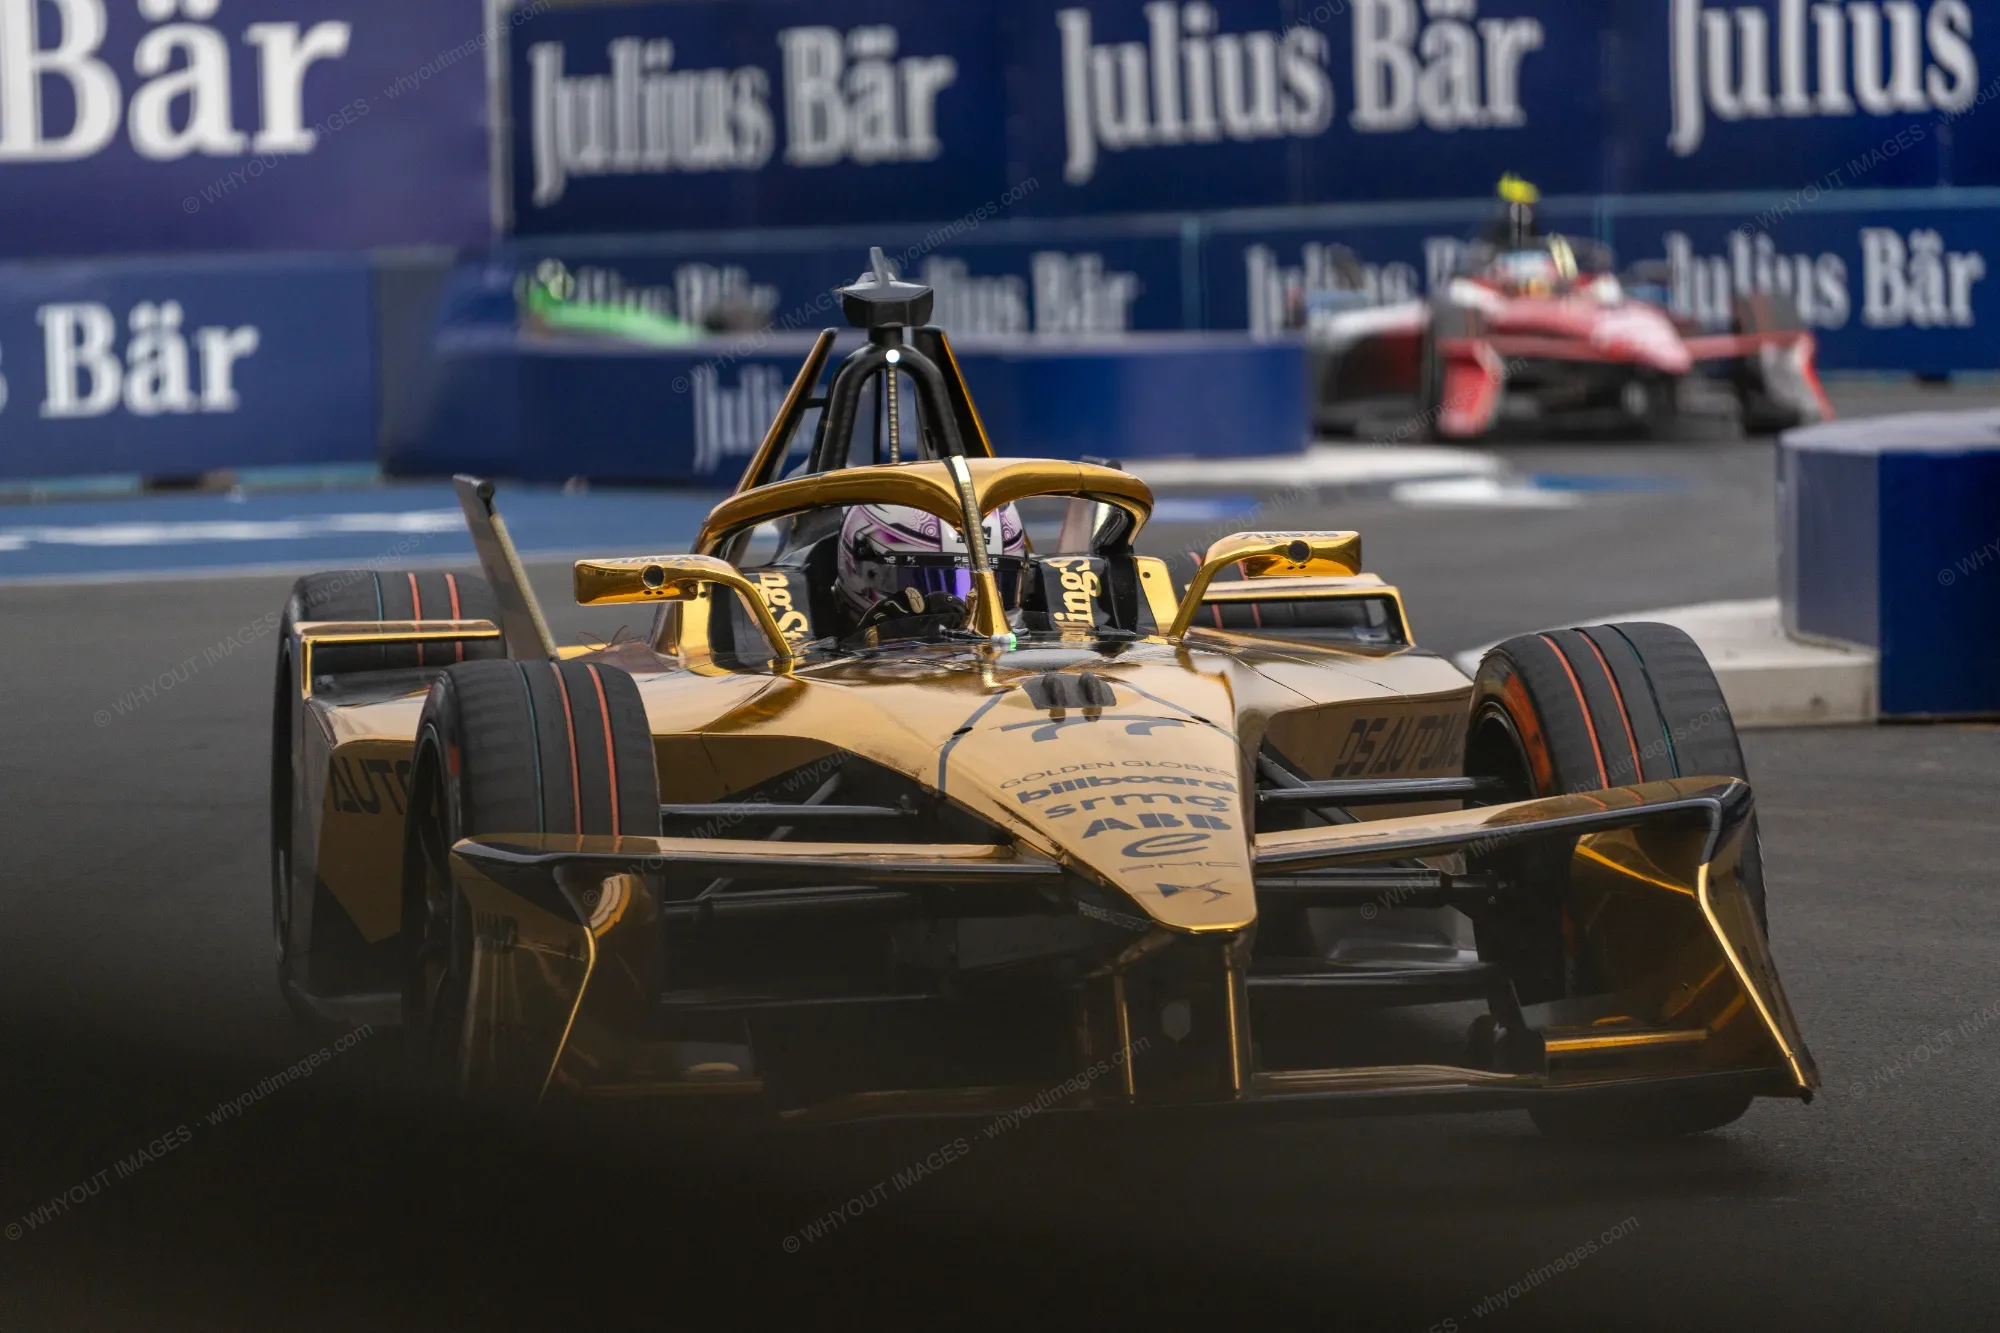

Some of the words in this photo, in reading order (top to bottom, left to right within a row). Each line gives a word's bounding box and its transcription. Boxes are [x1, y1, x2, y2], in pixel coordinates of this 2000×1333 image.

[0, 0, 352, 162] Bär
[529, 36, 774, 206] Julius
[779, 24, 958, 167] Bär
[1056, 0, 1334, 185] Julius
[1349, 0, 1545, 131] Bär
[1859, 226, 1986, 329] Bär
[37, 300, 260, 419] Bär
[999, 760, 1116, 790] GOLDEN
[1121, 759, 1237, 780] GLOBES
[1015, 775, 1239, 805] billboard
[1082, 812, 1233, 839] ABB
